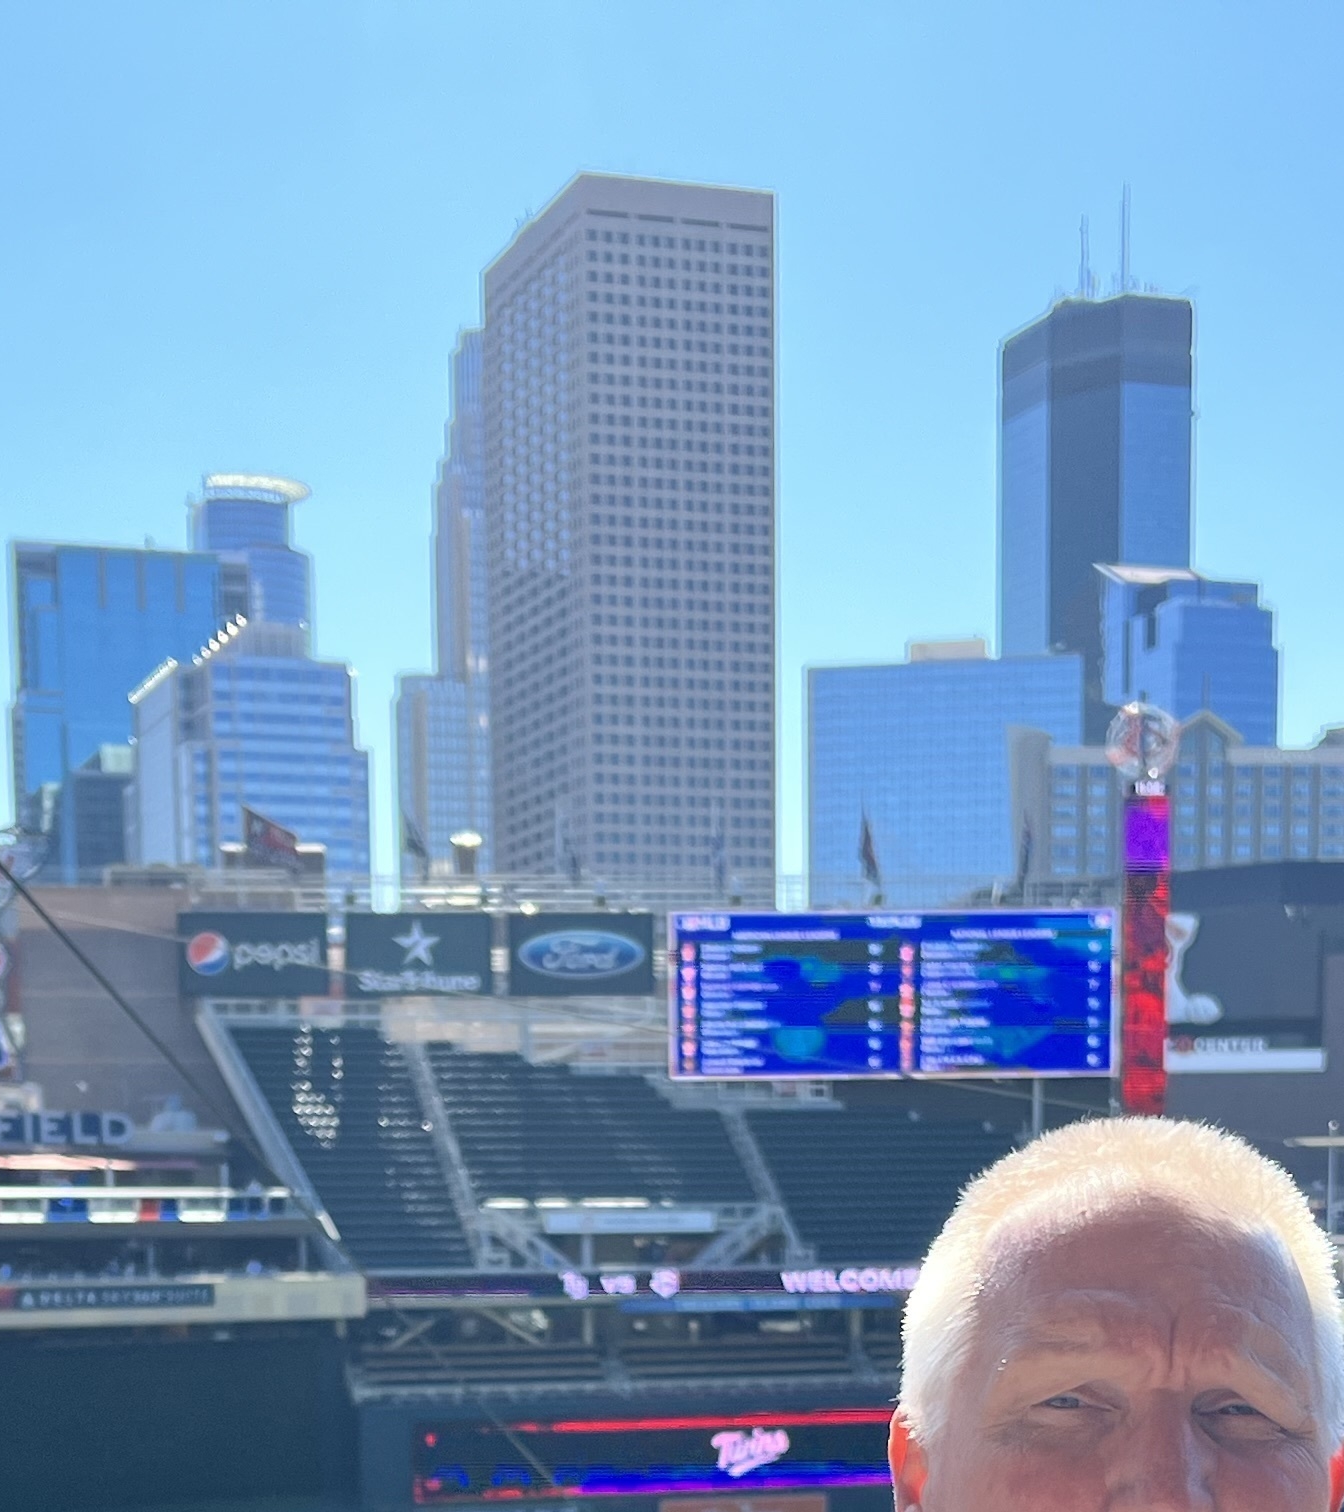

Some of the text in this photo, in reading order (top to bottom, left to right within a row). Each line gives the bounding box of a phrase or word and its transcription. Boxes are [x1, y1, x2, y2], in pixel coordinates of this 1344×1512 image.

[232, 937, 321, 972] pepsi
[542, 936, 620, 970] Ford
[780, 1268, 920, 1292] WELCOME
[711, 1427, 790, 1472] Twins
